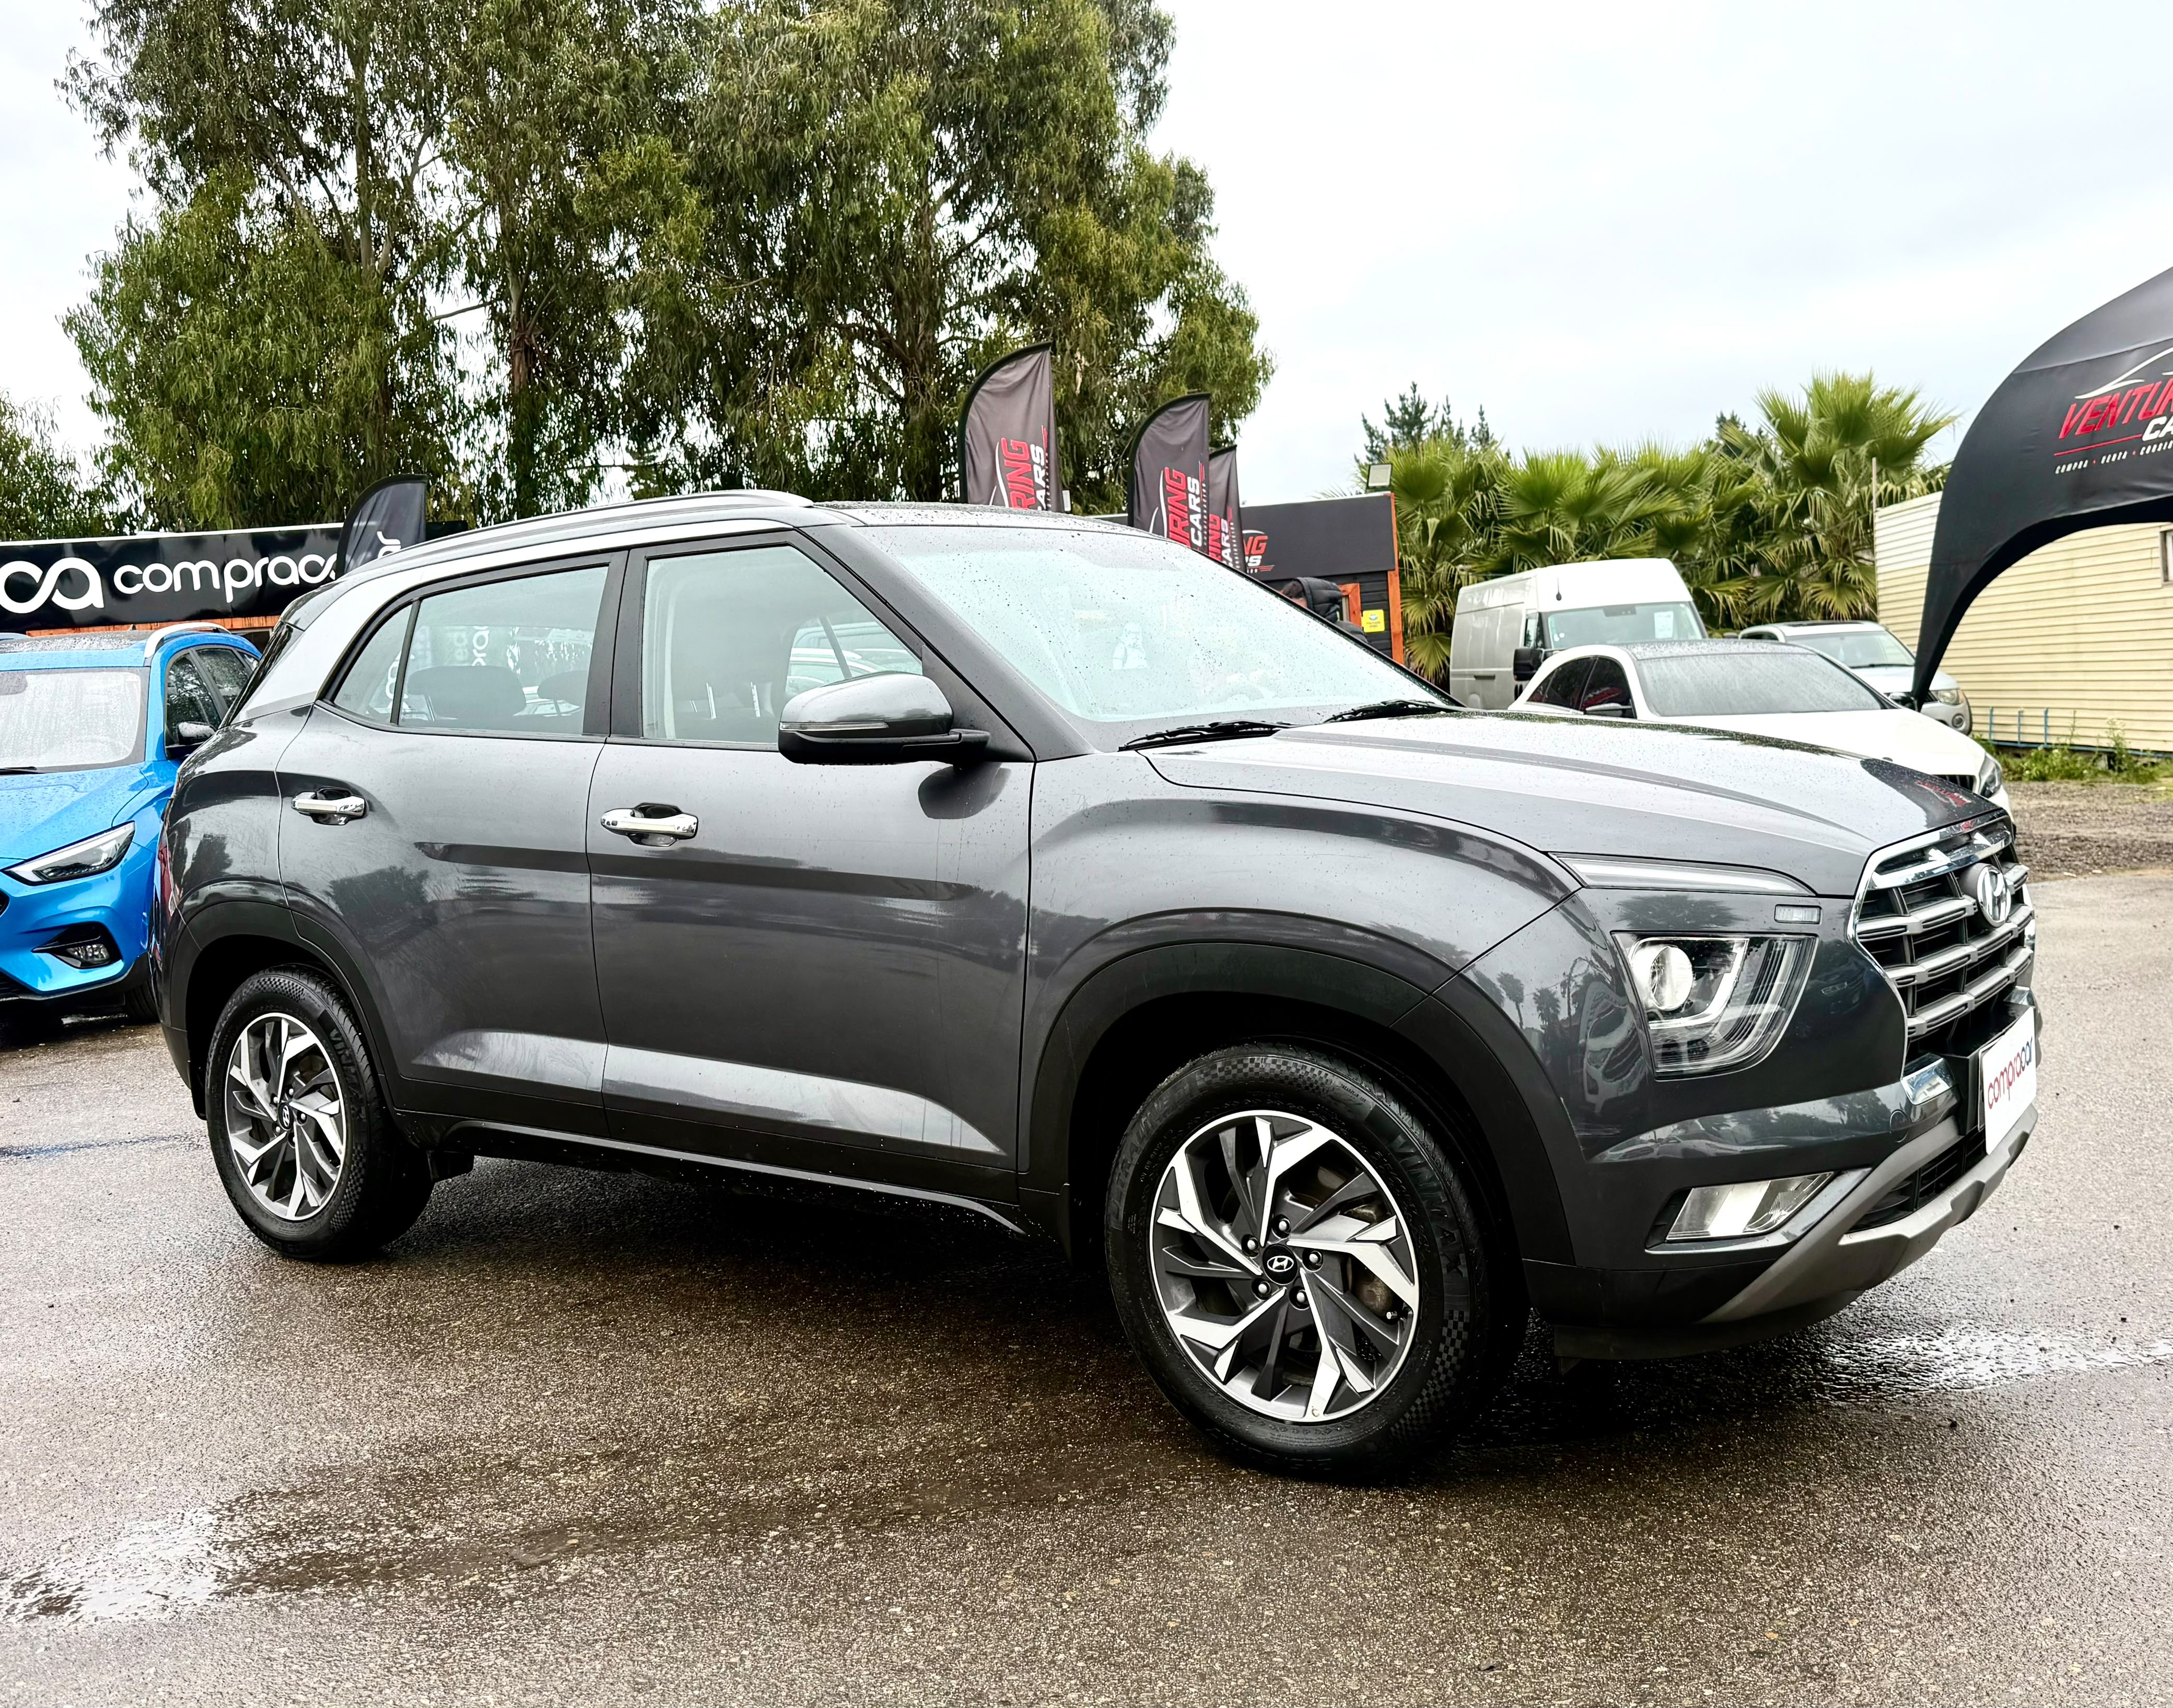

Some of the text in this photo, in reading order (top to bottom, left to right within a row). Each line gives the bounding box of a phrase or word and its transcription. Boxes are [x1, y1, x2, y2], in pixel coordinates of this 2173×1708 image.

[1030, 443, 1046, 511] ARS
[1187, 476, 1202, 547] CARS
[1988, 1036, 2032, 1109] compracar
